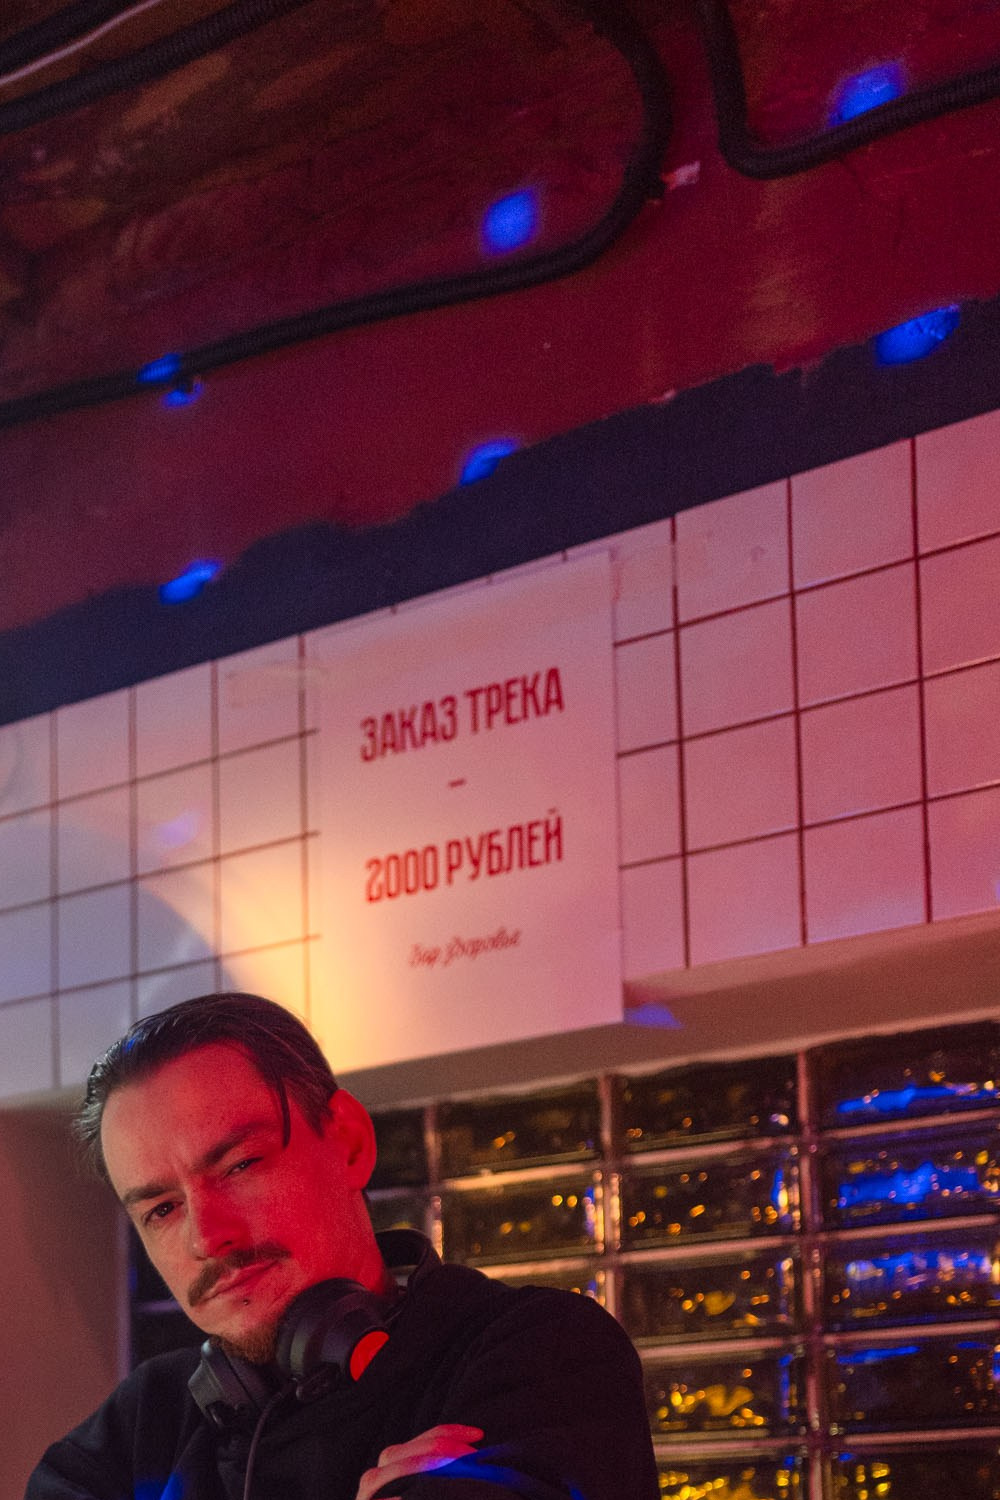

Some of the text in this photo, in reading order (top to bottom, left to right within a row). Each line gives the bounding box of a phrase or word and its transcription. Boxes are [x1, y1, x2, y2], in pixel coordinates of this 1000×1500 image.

[360, 666, 566, 763] ЗАКАЗ ТРЕКА
[364, 806, 565, 904] 2000 РУБЛЕЙ
